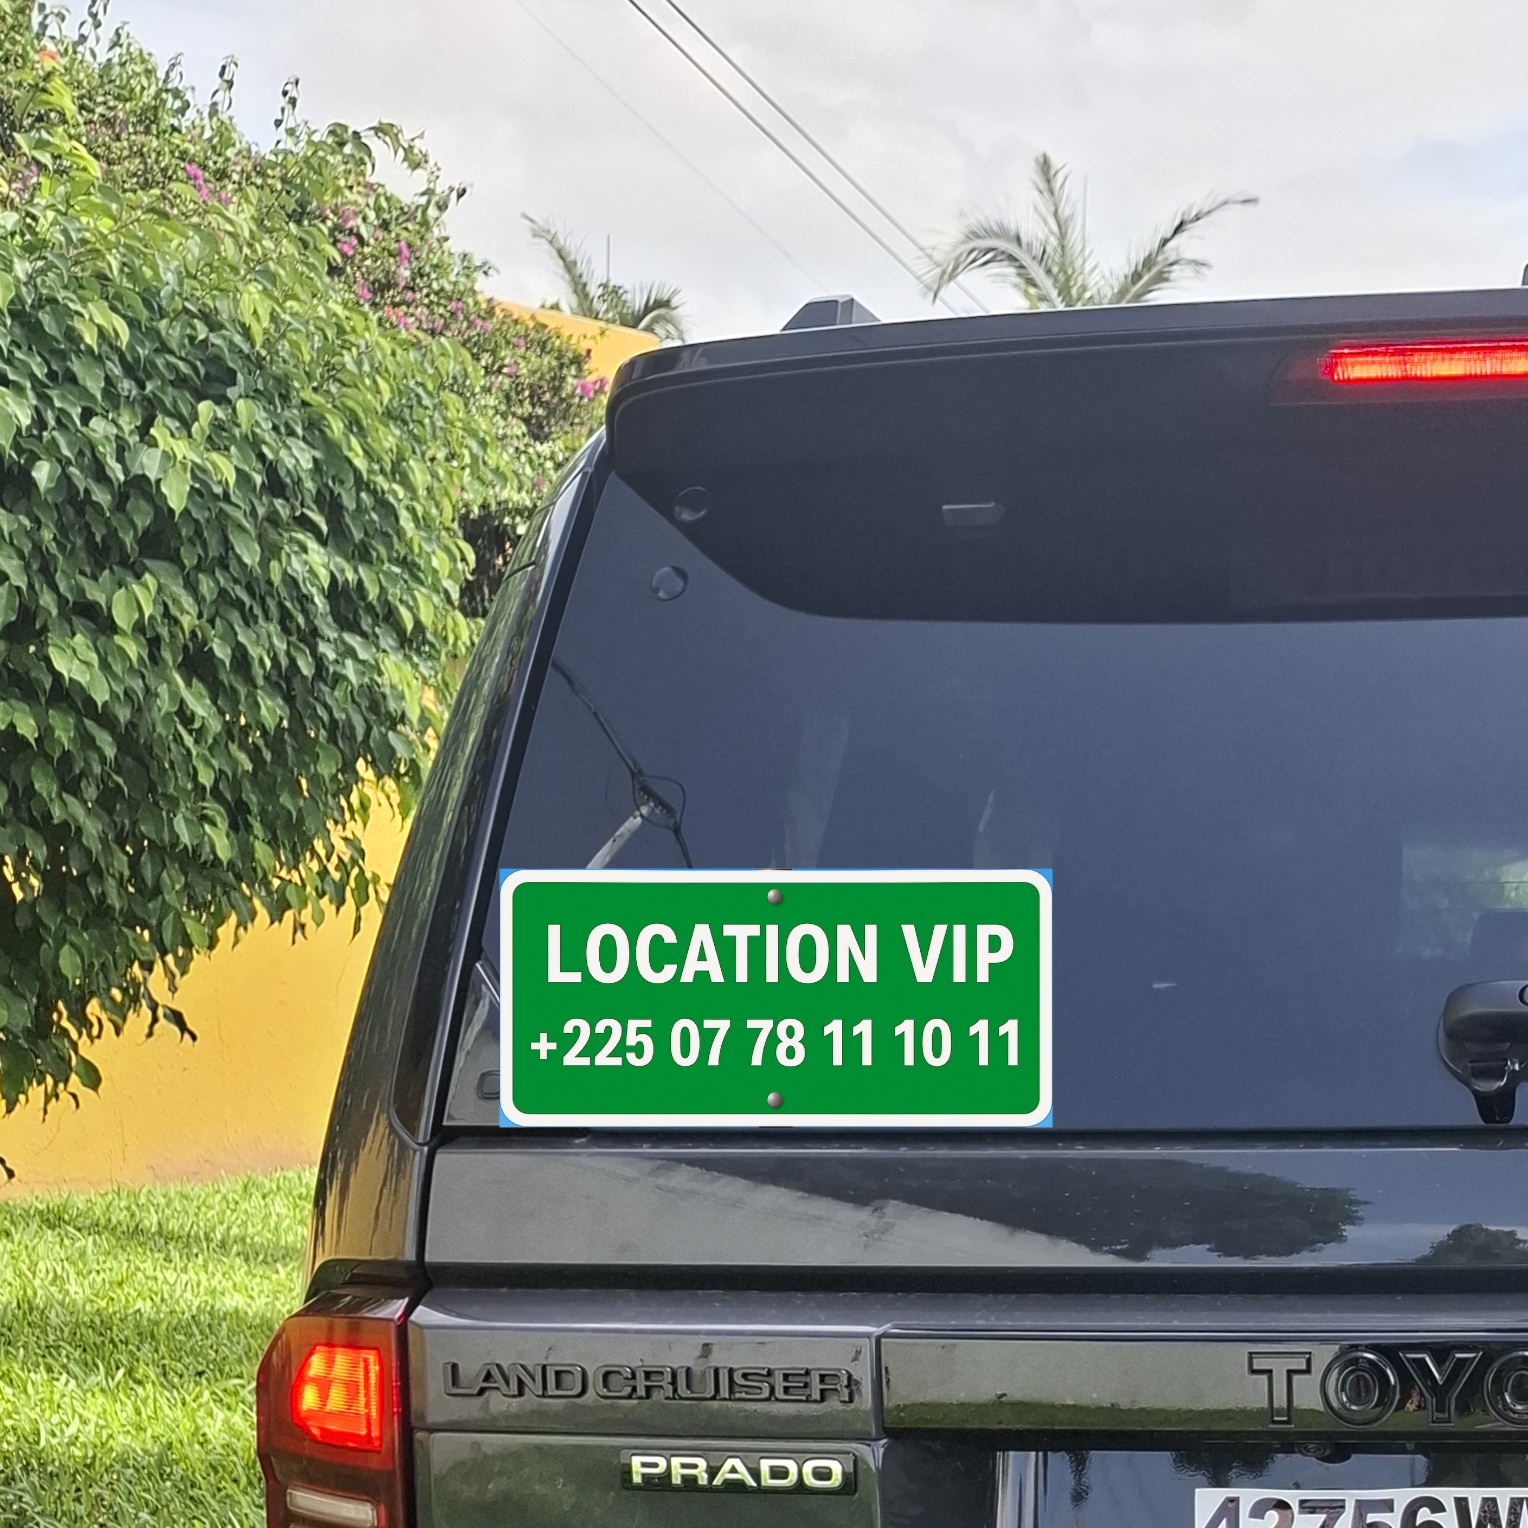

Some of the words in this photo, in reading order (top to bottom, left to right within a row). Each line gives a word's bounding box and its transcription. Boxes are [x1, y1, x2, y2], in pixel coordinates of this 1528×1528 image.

[444, 1361, 588, 1398] LAND
[594, 1364, 856, 1403] CRUISER
[629, 1453, 845, 1489] PRADO
